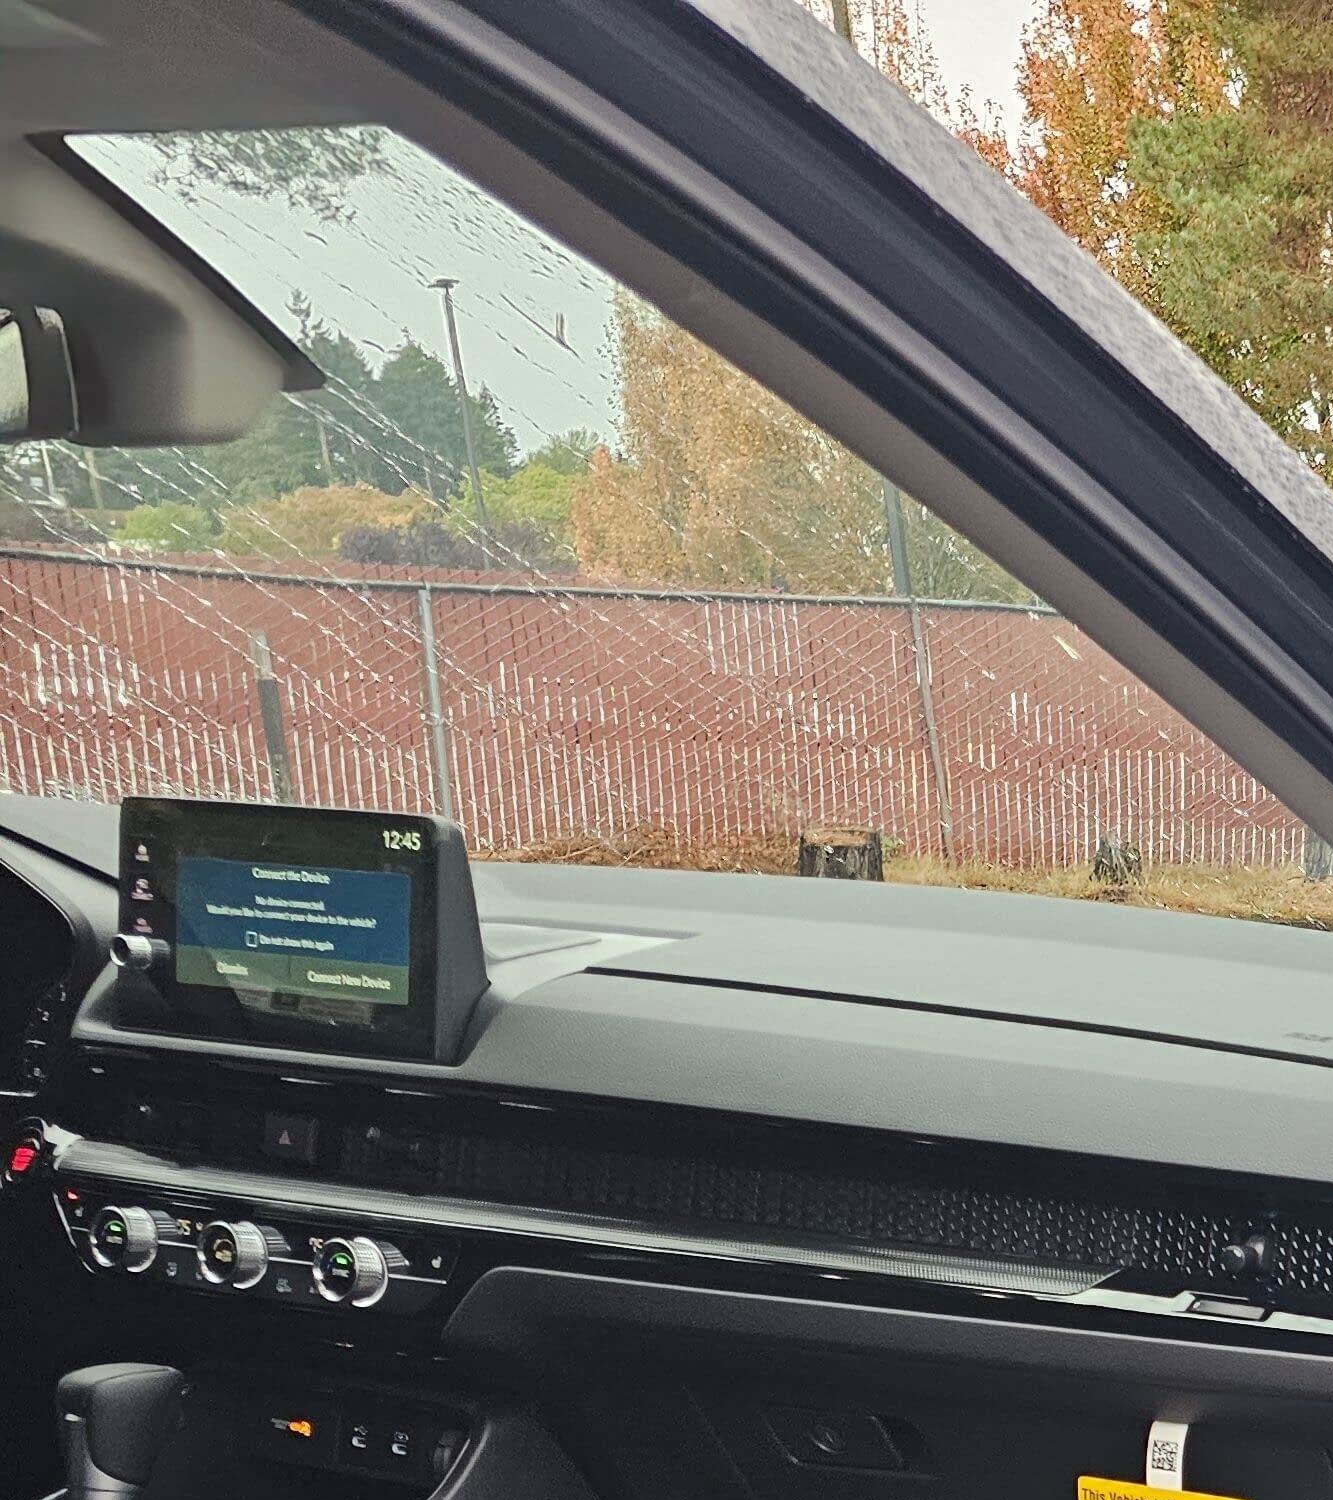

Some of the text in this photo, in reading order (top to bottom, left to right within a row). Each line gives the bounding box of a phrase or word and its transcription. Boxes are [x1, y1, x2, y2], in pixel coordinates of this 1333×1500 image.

[383, 830, 421, 851] 12:45
[252, 866, 287, 881] Connect
[301, 870, 331, 885] Device
[307, 970, 391, 990] Connect New Device
